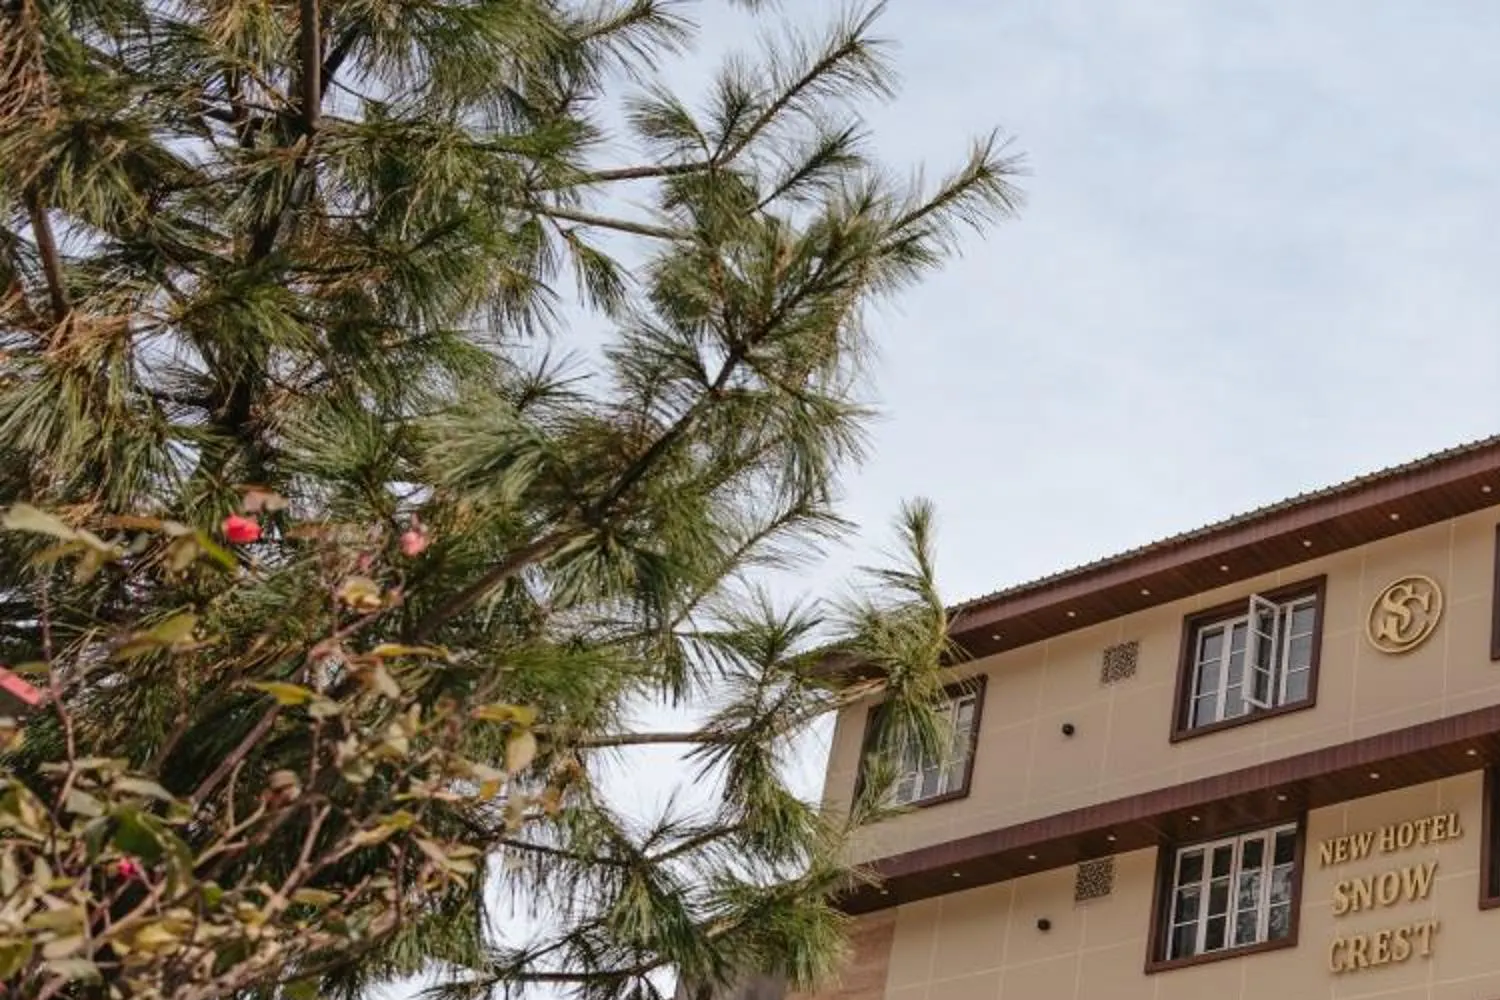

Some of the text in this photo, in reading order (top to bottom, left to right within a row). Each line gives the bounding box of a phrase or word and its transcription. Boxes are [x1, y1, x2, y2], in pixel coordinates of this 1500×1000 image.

[1319, 813, 1462, 867] NEW HOTEL
[1332, 861, 1438, 916] SNOW
[1328, 919, 1440, 973] CREST
